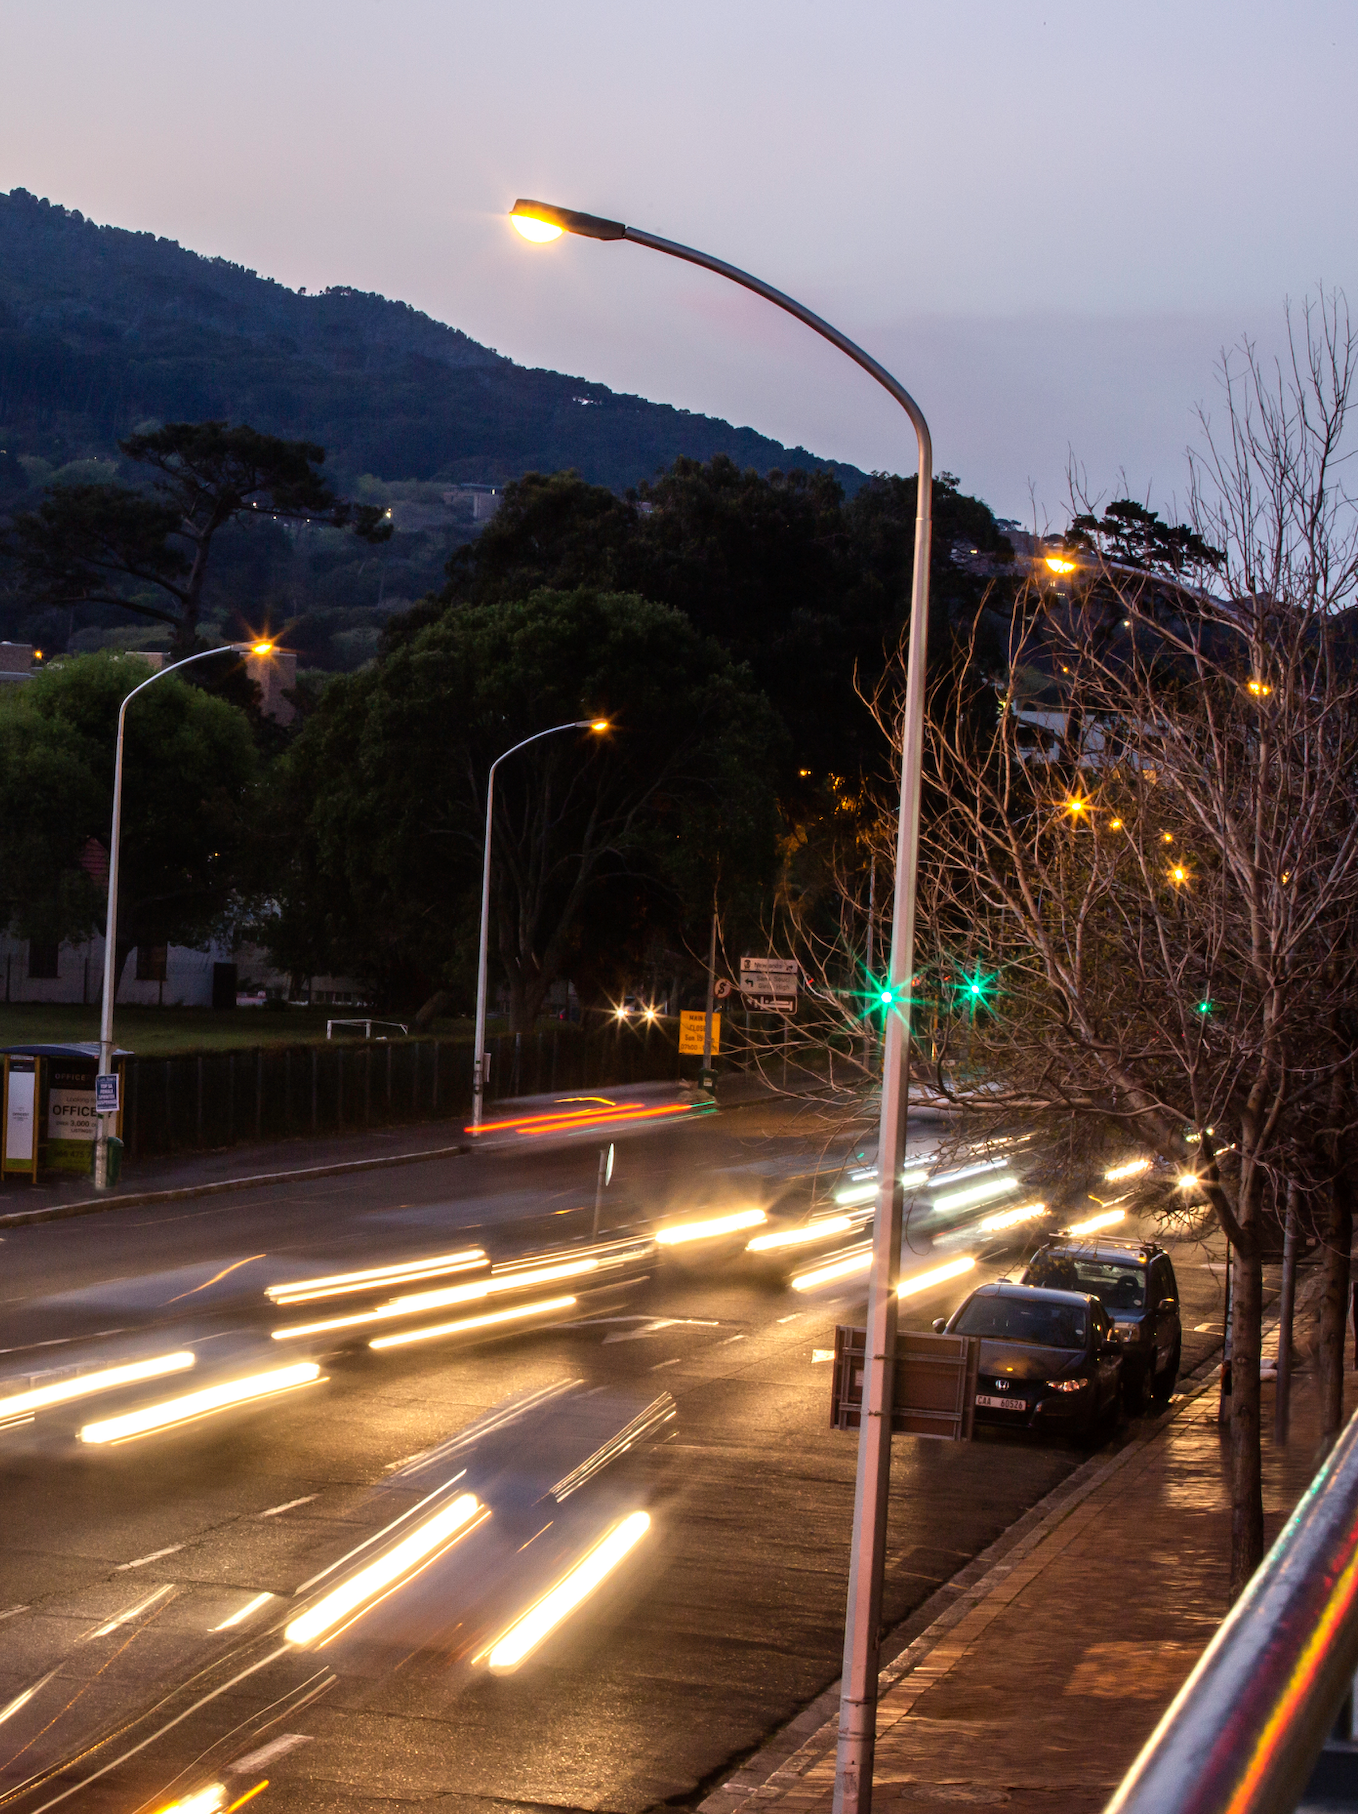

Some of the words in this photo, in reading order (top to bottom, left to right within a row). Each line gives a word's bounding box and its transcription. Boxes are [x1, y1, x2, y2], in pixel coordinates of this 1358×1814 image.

[754, 961, 784, 969] Newands
[689, 1014, 704, 1022] MAIN
[977, 1395, 992, 1406] CAA
[1000, 1399, 1023, 1410] 60526
